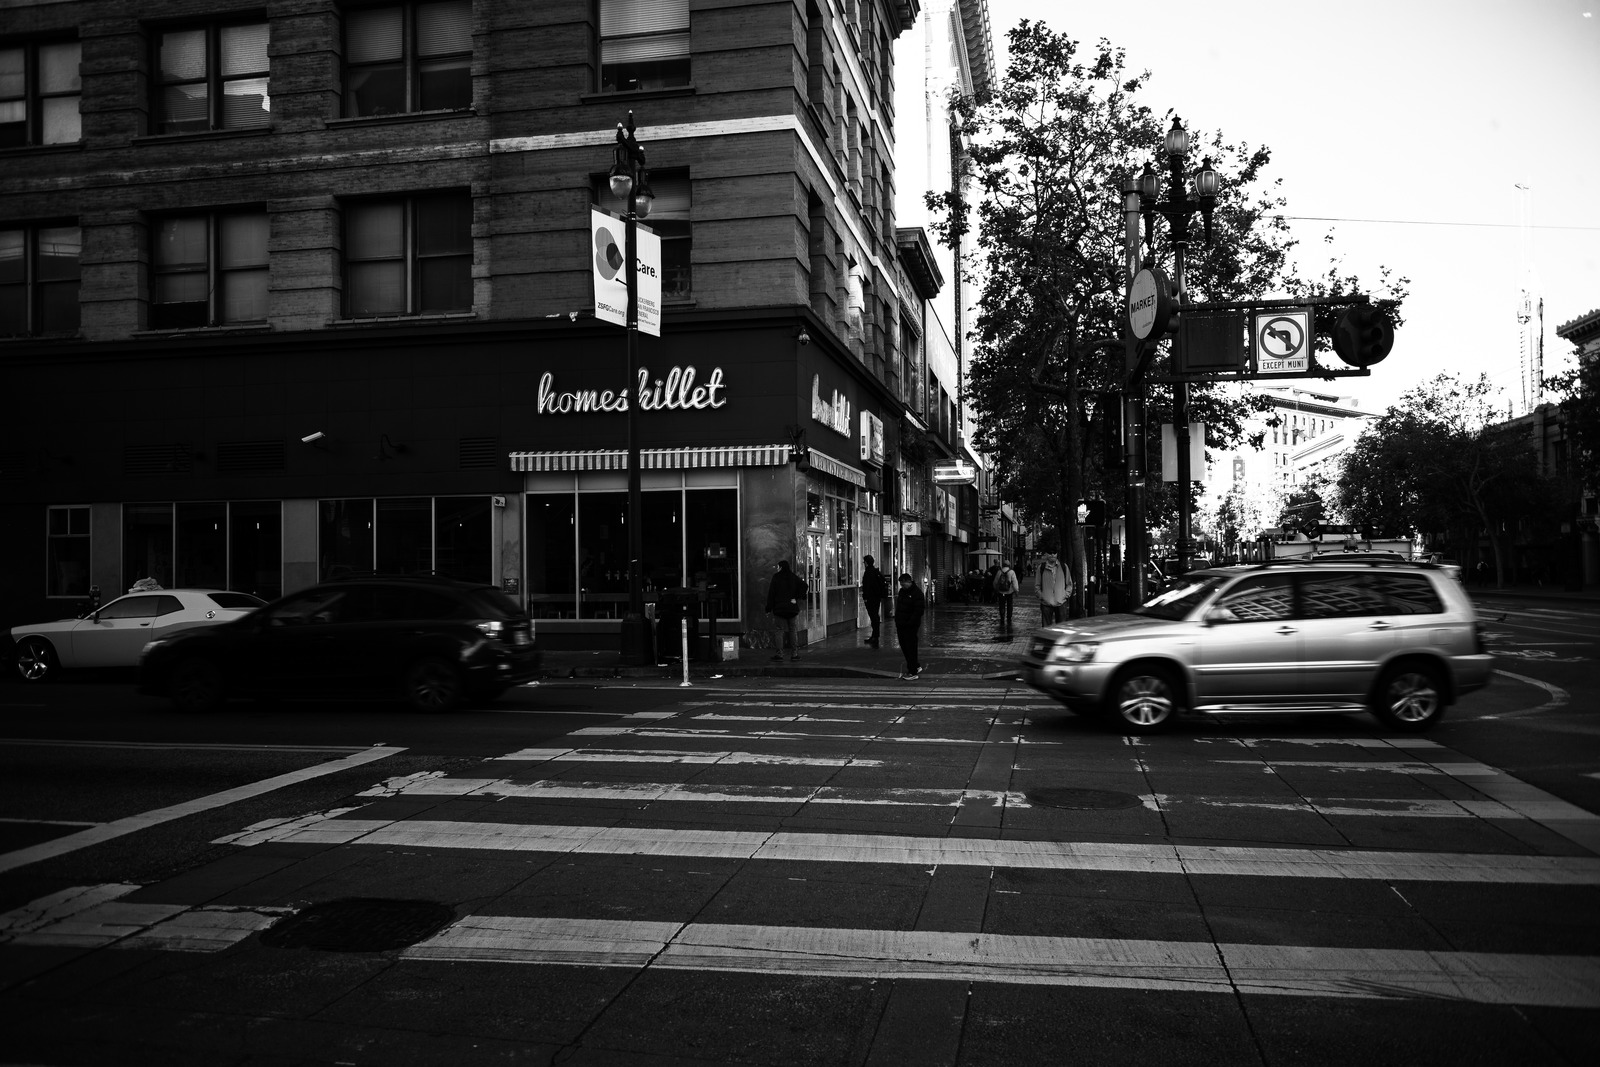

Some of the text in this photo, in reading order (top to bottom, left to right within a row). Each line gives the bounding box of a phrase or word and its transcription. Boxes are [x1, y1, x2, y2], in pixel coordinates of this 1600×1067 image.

[636, 258, 658, 278] Care.
[1131, 294, 1155, 313] MARKET
[1262, 360, 1304, 370] EXCEPT MUNI
[537, 365, 727, 415] homeskillet
